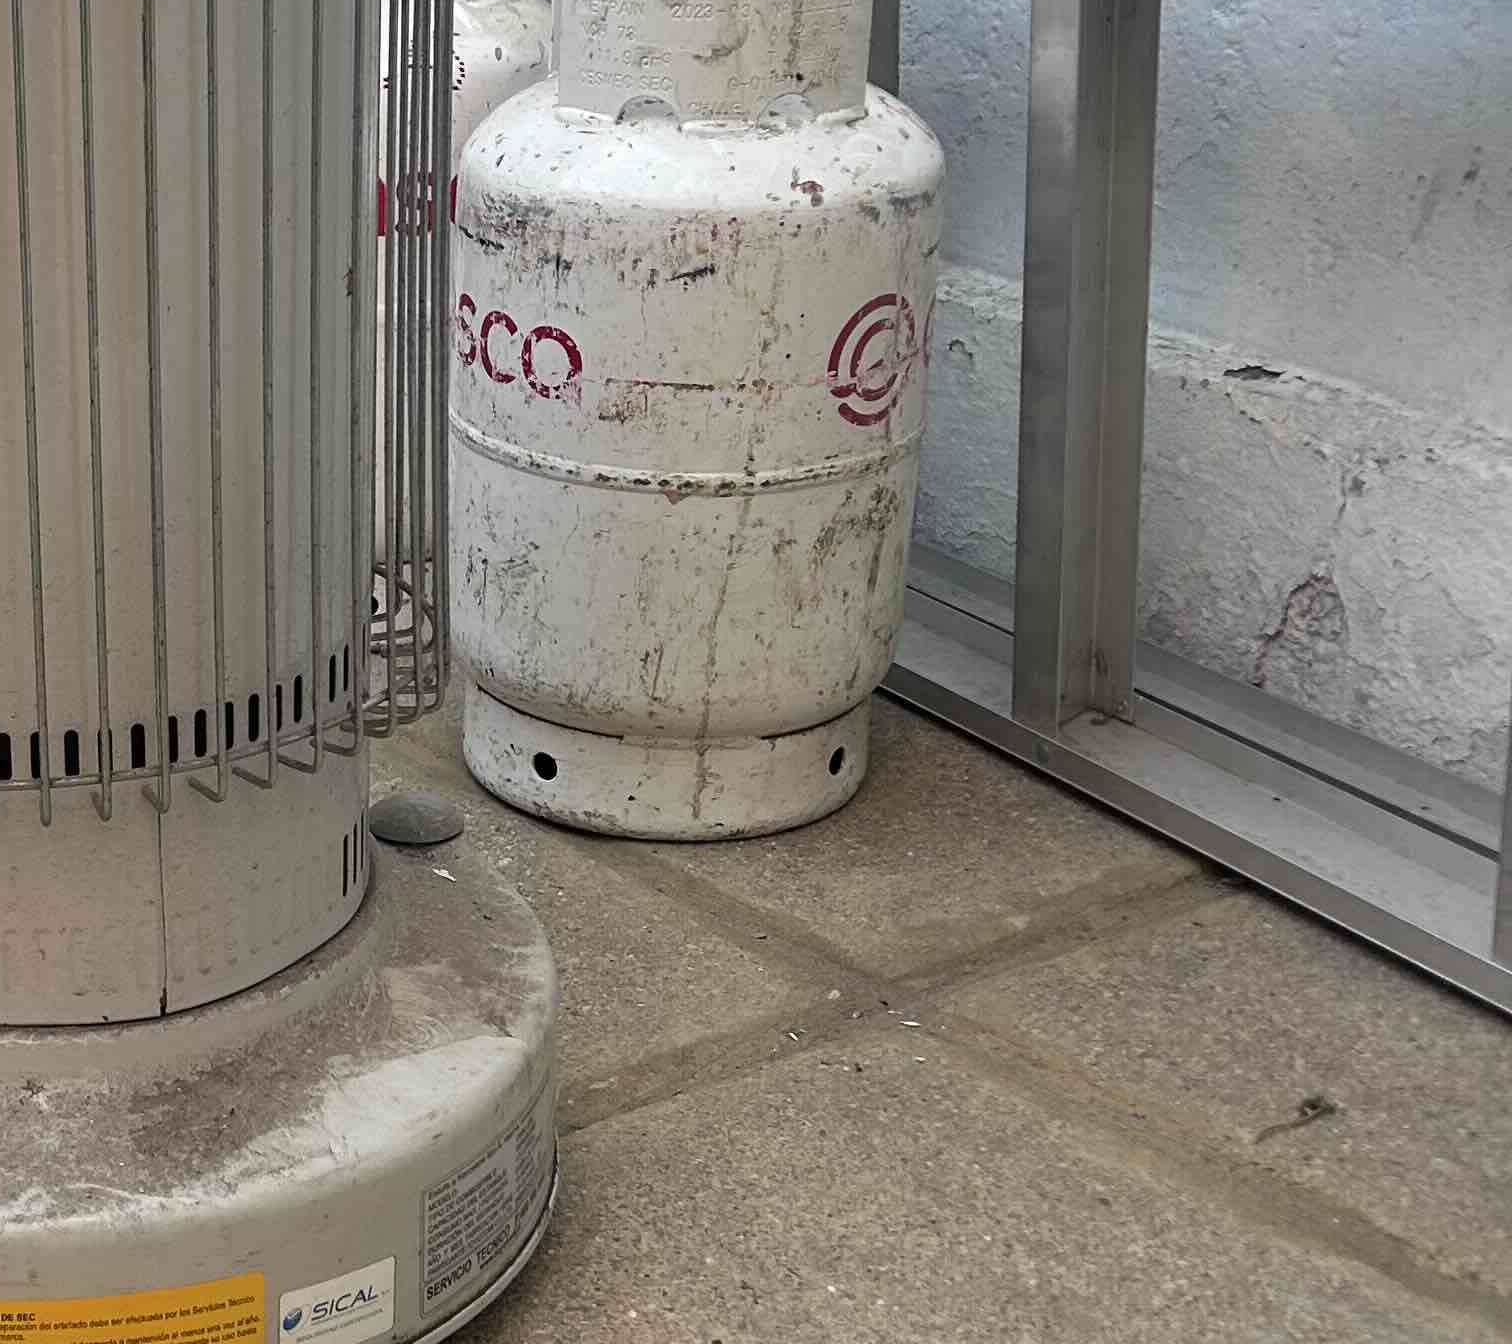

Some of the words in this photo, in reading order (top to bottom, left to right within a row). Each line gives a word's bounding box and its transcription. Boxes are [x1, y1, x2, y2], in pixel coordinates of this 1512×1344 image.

[426, 1258, 473, 1300] SERVICIO
[1, 1313, 15, 1322] DE
[311, 1284, 379, 1322] SICAL
